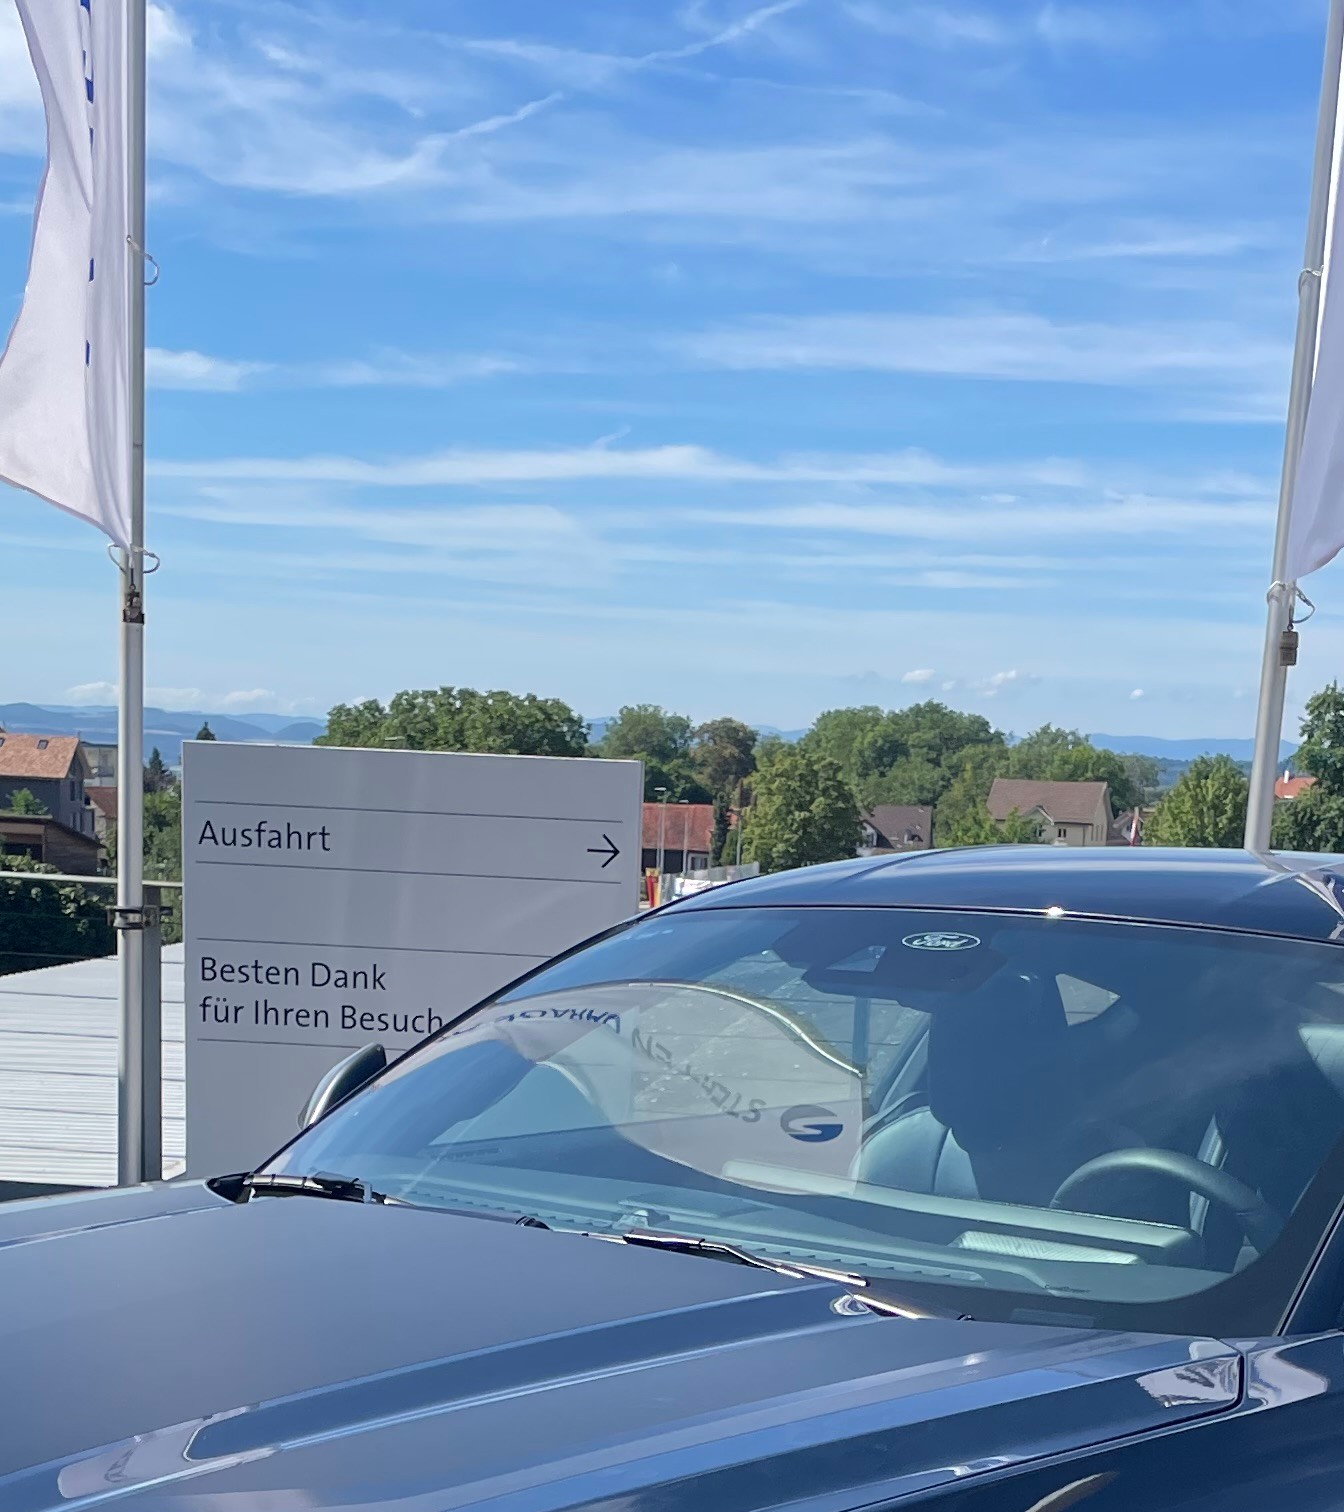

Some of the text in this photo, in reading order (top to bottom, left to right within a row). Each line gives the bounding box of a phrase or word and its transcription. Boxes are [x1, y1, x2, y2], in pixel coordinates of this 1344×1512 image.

[198, 820, 331, 851] Ausfahrt
[201, 956, 387, 990] Besten Dank
[199, 996, 244, 1024] für
[255, 999, 329, 1028] Ihren
[341, 1004, 443, 1034] Besuch
